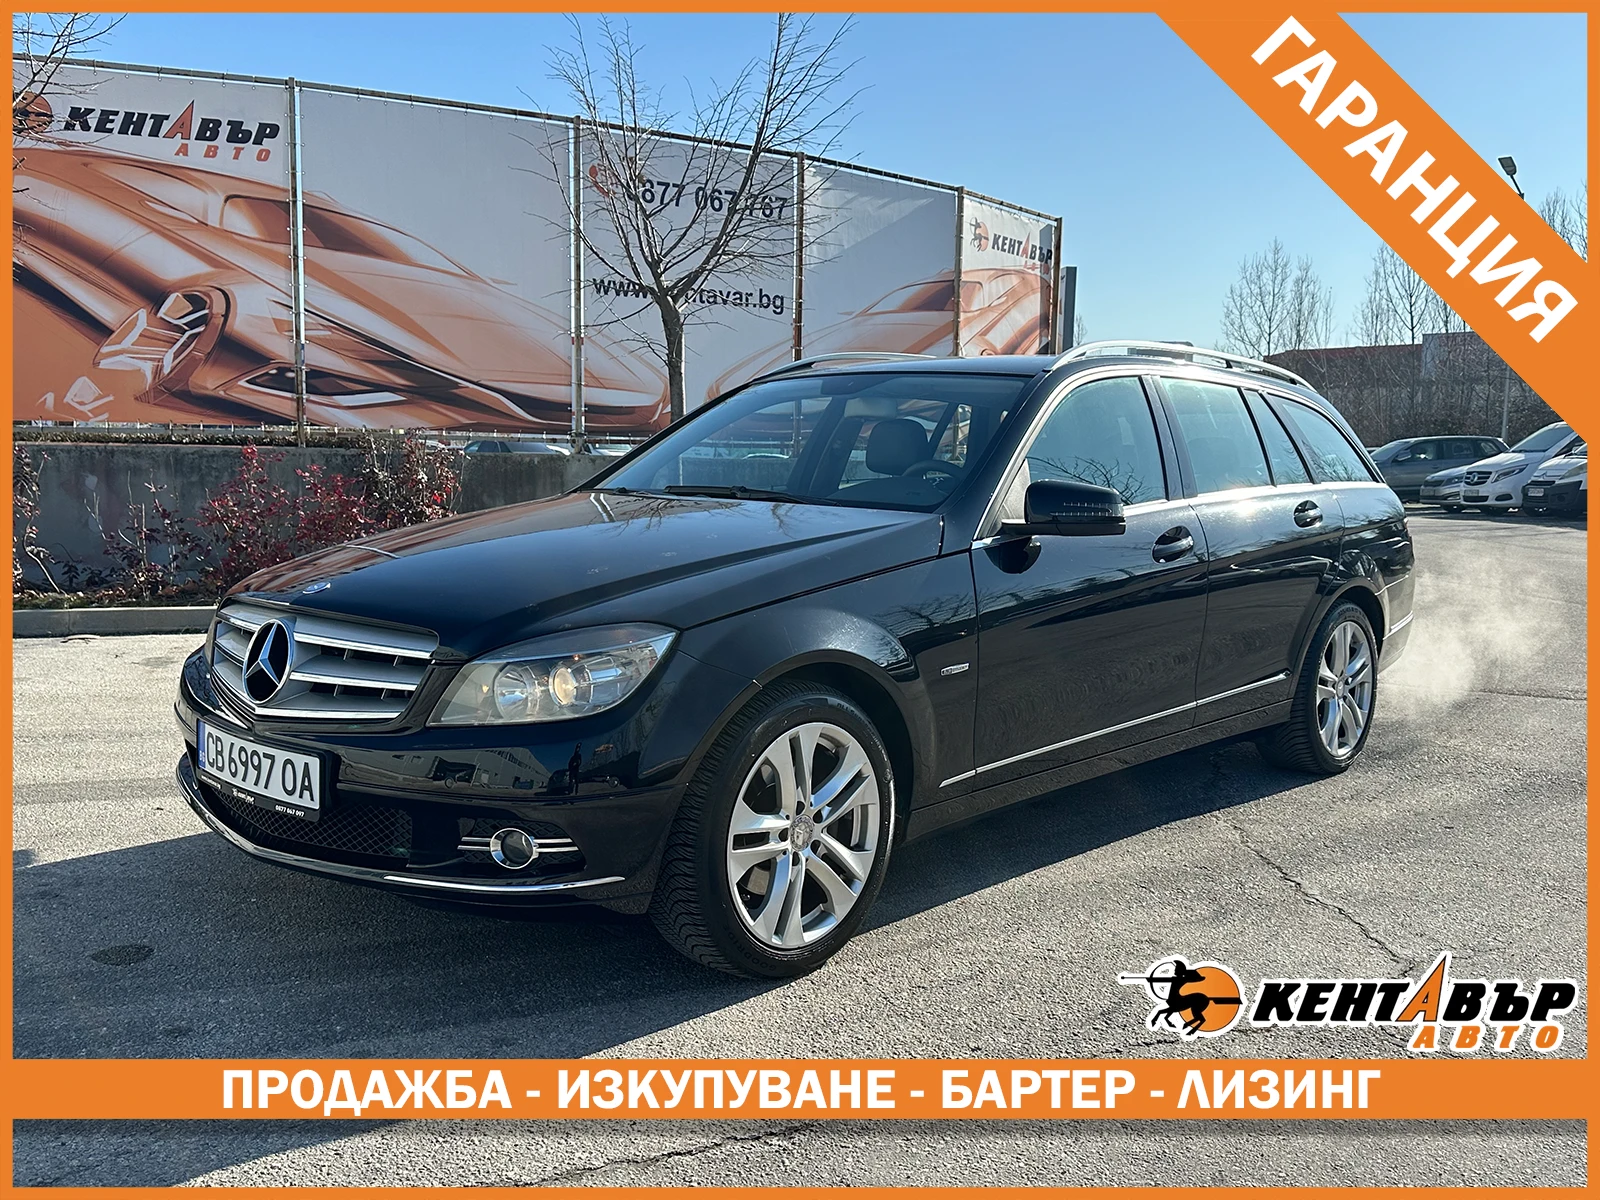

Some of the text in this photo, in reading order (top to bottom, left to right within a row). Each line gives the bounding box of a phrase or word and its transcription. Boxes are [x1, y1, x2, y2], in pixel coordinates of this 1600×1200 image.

[64, 99, 280, 146] КЕНТАВЪР
[174, 142, 271, 162] АВТО
[228, 741, 276, 790] 6997
